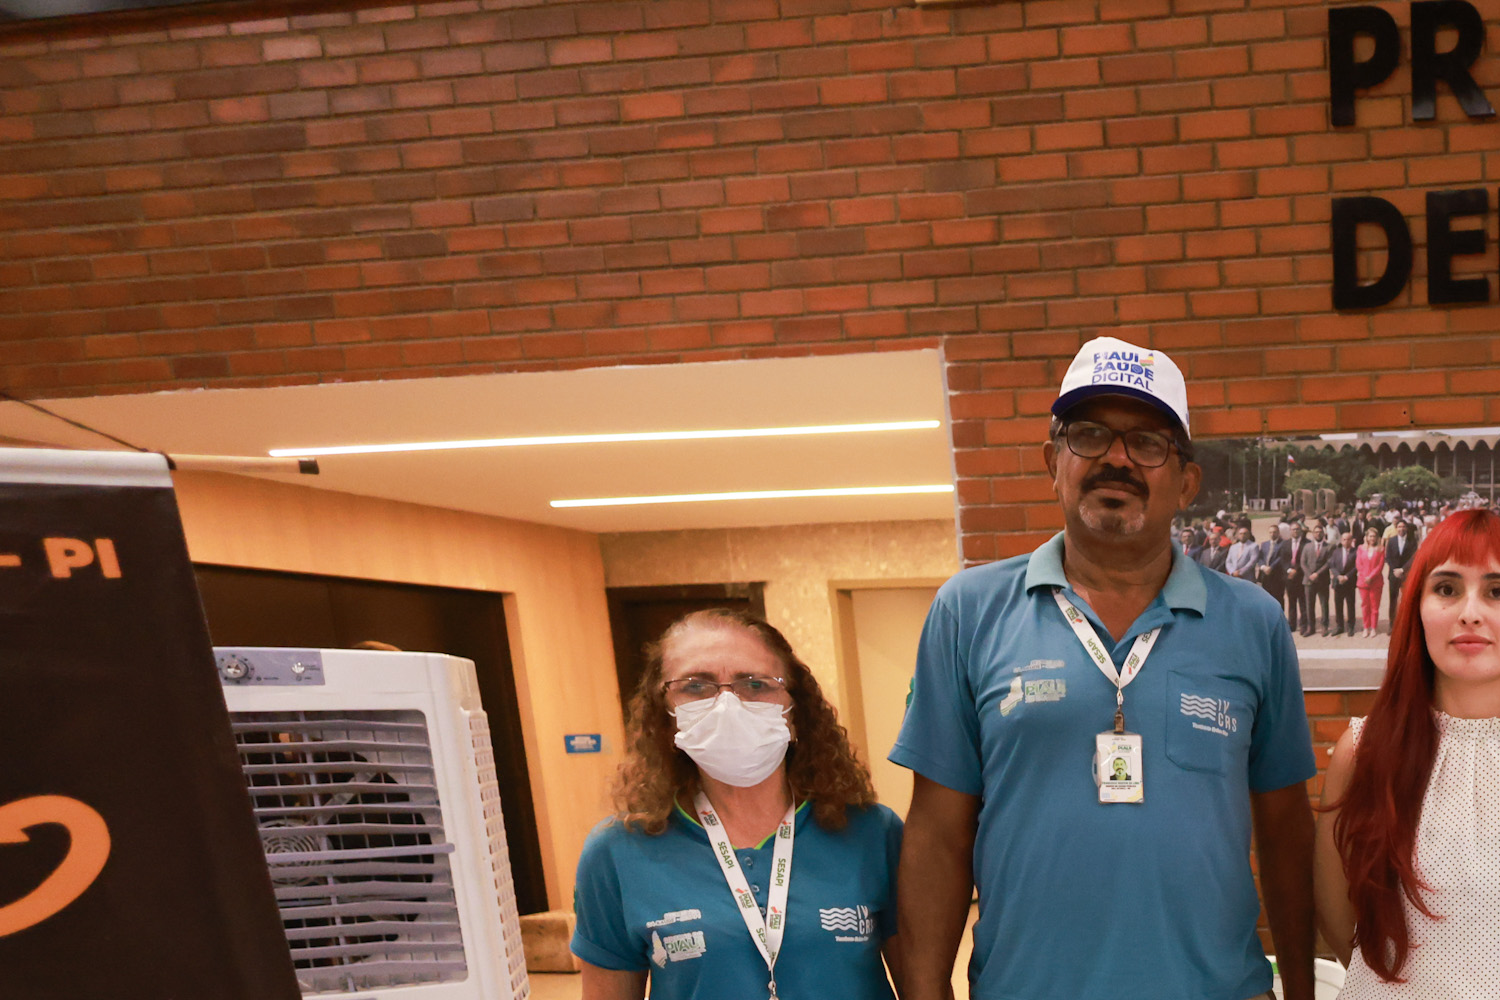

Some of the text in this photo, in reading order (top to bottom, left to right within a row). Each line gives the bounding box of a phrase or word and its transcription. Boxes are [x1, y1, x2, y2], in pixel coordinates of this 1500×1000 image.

[1092, 372, 1153, 392] DIGITAL
[42, 537, 122, 579] PI
[1218, 712, 1237, 732] CRS
[717, 841, 735, 869] SESAPI
[774, 858, 787, 887] SESAPI
[859, 919, 873, 935] CR
